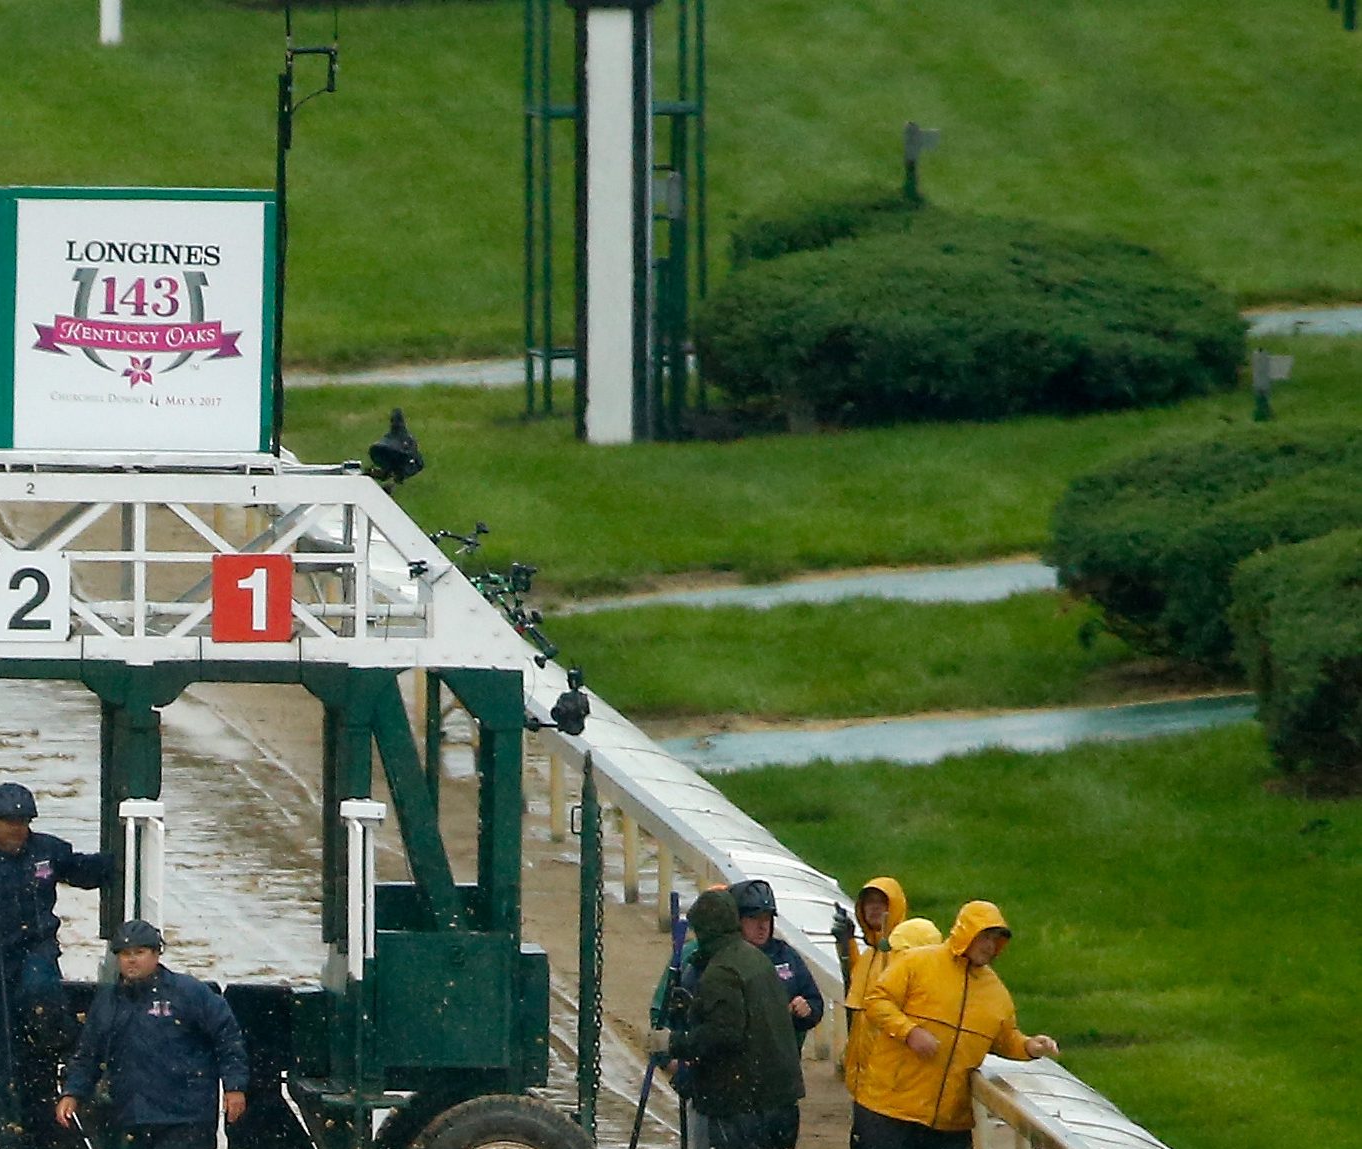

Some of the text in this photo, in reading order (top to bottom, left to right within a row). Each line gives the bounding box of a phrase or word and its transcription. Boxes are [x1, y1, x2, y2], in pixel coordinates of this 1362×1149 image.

[65, 240, 221, 267] LONGINES
[100, 276, 180, 317] 143
[59, 320, 216, 347] KENTUCKY OAKS
[198, 397, 222, 407] 2017
[27, 483, 34, 494] 2
[251, 485, 256, 496] 1
[6, 567, 52, 631] 2
[237, 566, 268, 631] 1
